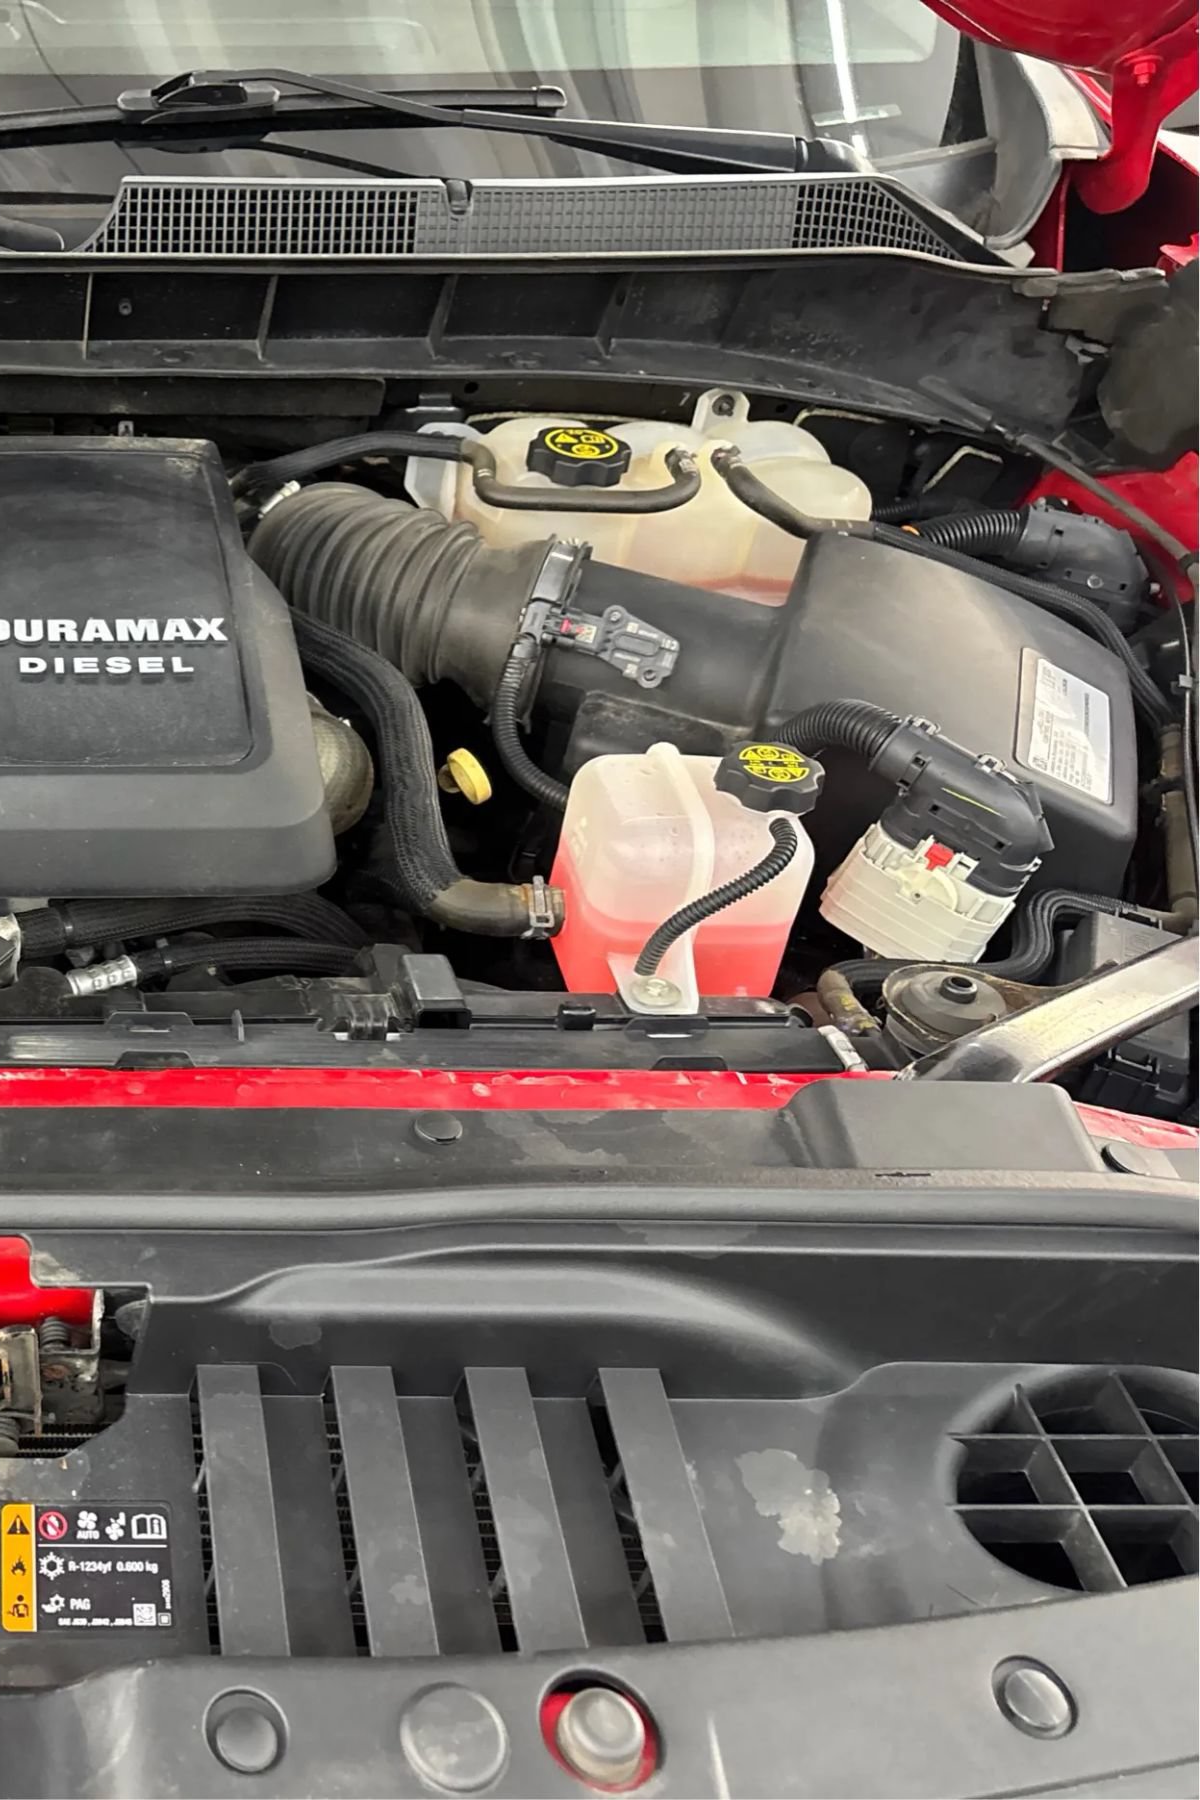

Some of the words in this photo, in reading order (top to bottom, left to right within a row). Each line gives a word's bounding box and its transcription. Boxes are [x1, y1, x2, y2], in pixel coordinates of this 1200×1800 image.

[19, 656, 194, 674] DIESEL
[76, 1531, 99, 1540] AUTO
[68, 1561, 112, 1574] R-1234yf
[146, 1561, 158, 1574] kg
[70, 1598, 91, 1610] PAG
